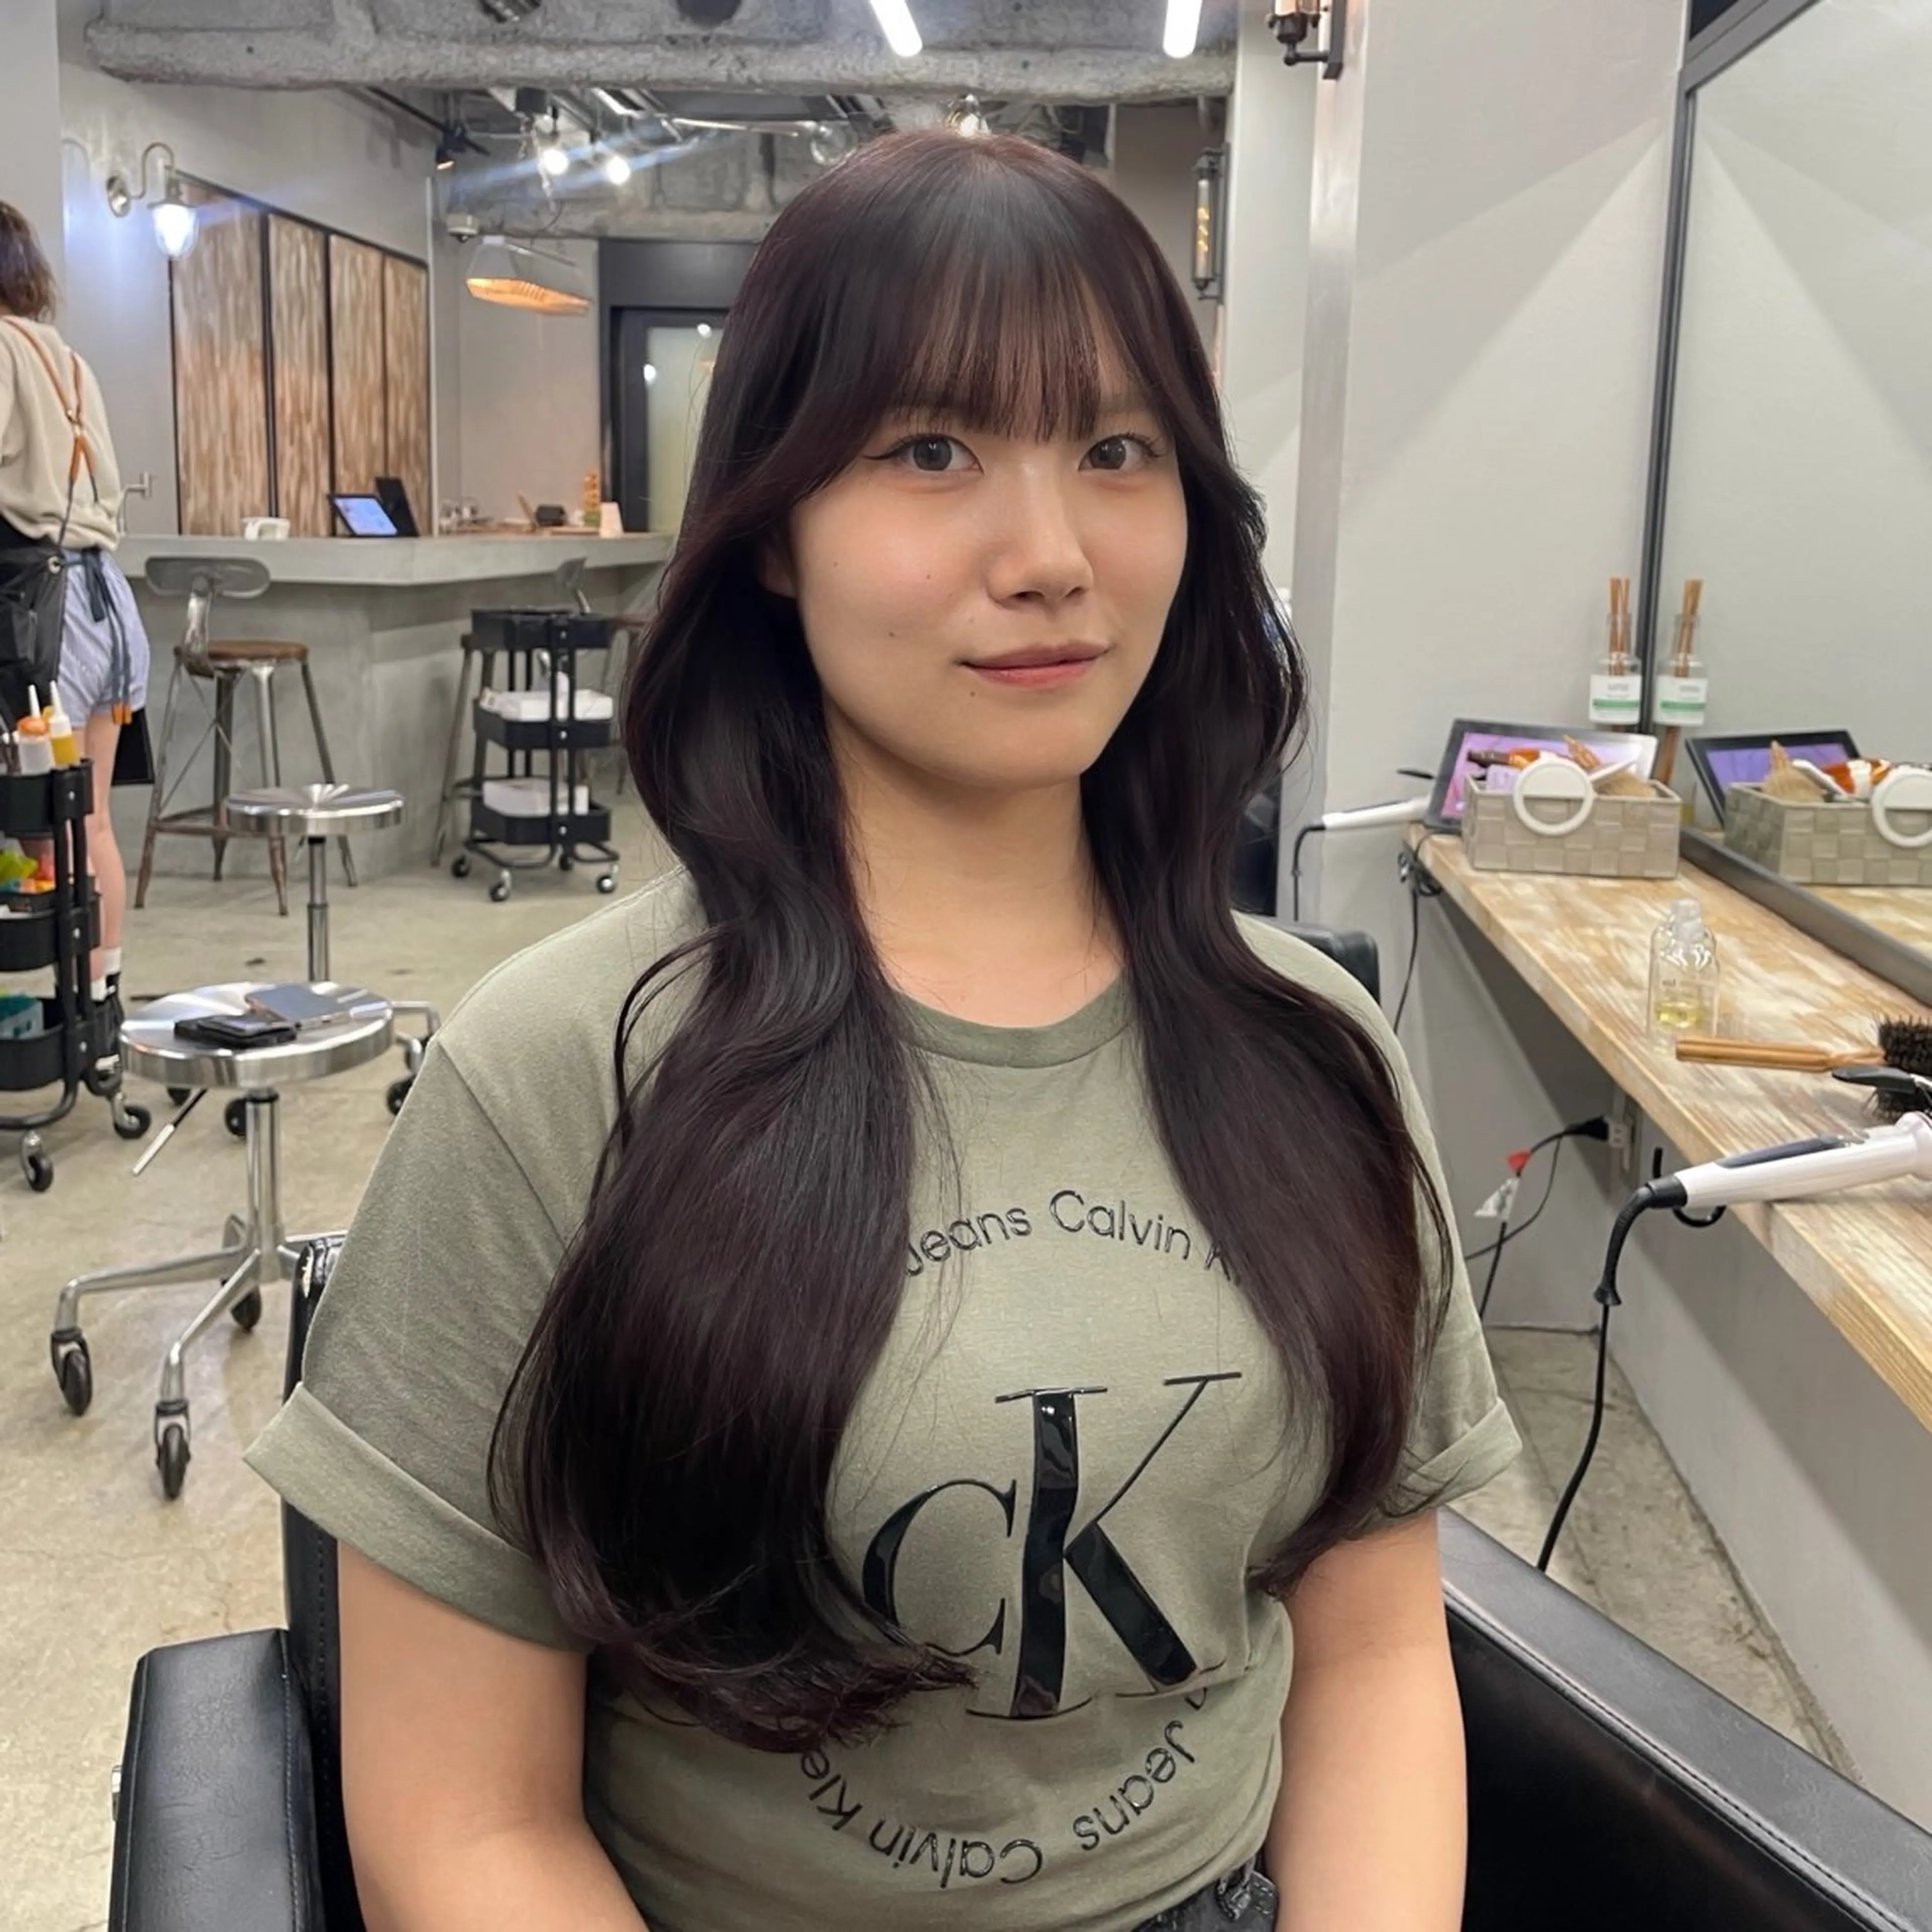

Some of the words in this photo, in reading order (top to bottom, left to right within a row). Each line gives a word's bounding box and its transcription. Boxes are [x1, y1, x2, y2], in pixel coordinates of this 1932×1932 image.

[1050, 1189, 1191, 1260] Calvin
[1073, 1720, 1195, 1851] Jeans
[869, 1818, 1043, 1888] Calvin
